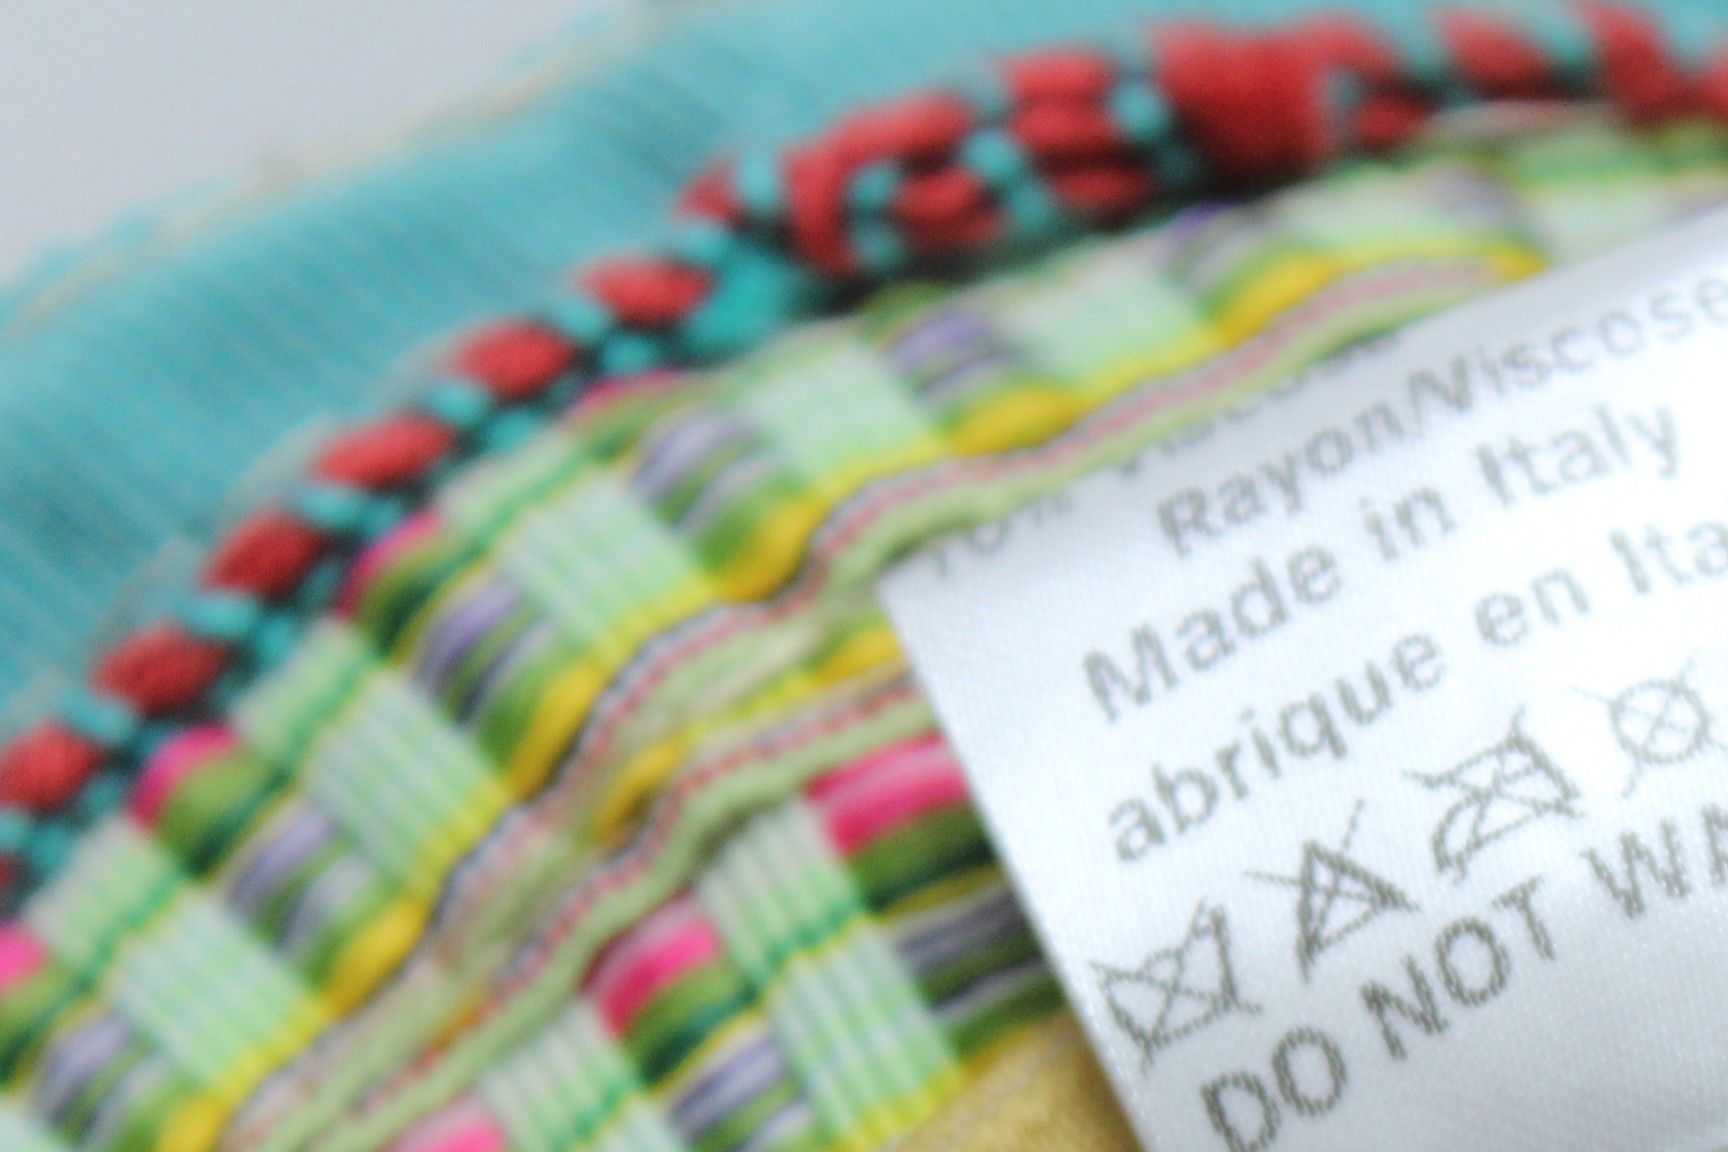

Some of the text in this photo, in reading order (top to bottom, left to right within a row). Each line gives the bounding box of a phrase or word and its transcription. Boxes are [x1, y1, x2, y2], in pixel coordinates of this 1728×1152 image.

[1080, 543, 1344, 724] Made
[1357, 474, 1457, 563] in
[1474, 404, 1684, 510] Italy
[1107, 631, 1448, 863] abrique
[1474, 564, 1590, 648] en
[1359, 876, 1556, 1060] NOT
